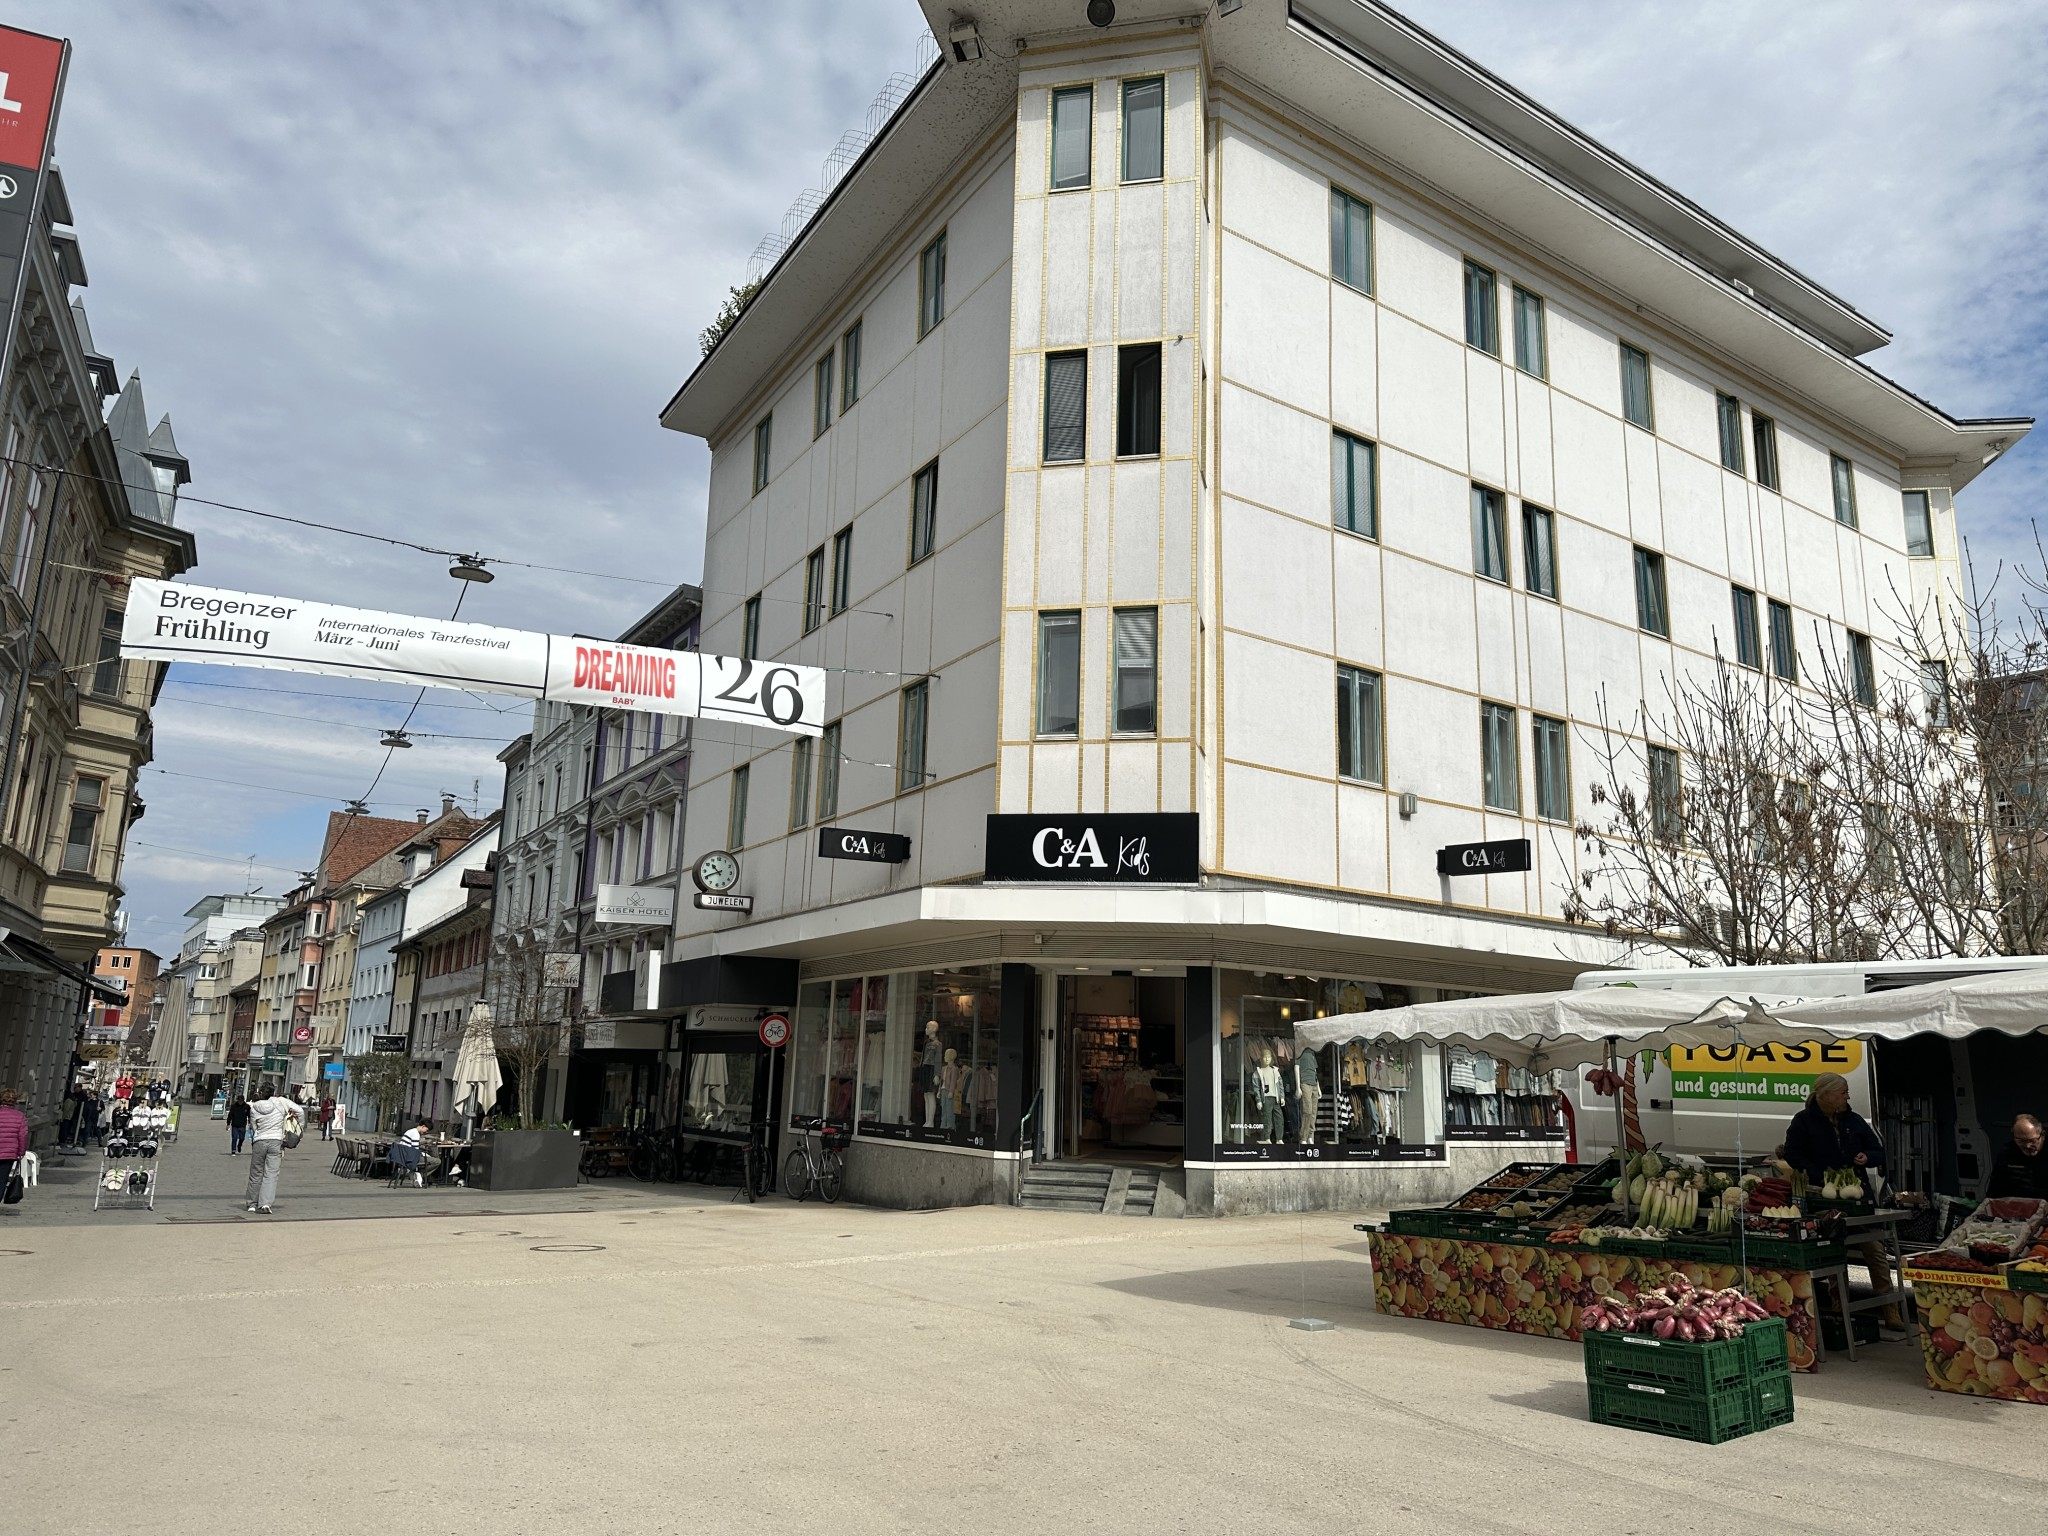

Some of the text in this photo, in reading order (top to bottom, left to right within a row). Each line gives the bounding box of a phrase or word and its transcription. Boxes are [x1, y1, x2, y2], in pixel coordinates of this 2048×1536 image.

[160, 590, 297, 619] Bregenzer
[154, 615, 271, 649] Frühling
[314, 630, 354, 646] März
[366, 636, 401, 651] Juni
[318, 617, 511, 650] Internationales Tanzfestival
[573, 646, 676, 699] DREAMING
[612, 696, 636, 706] BABY
[841, 835, 870, 854] C&A
[1032, 827, 1150, 876] C&A Kids
[1461, 848, 1490, 867] C&A
[600, 906, 635, 914] KAISER
[708, 896, 744, 906] JUWELEN
[1675, 1076, 1703, 1093] und
[1710, 1077, 1767, 1098] gesund
[1924, 1272, 1982, 1286] DIMITRIOS
